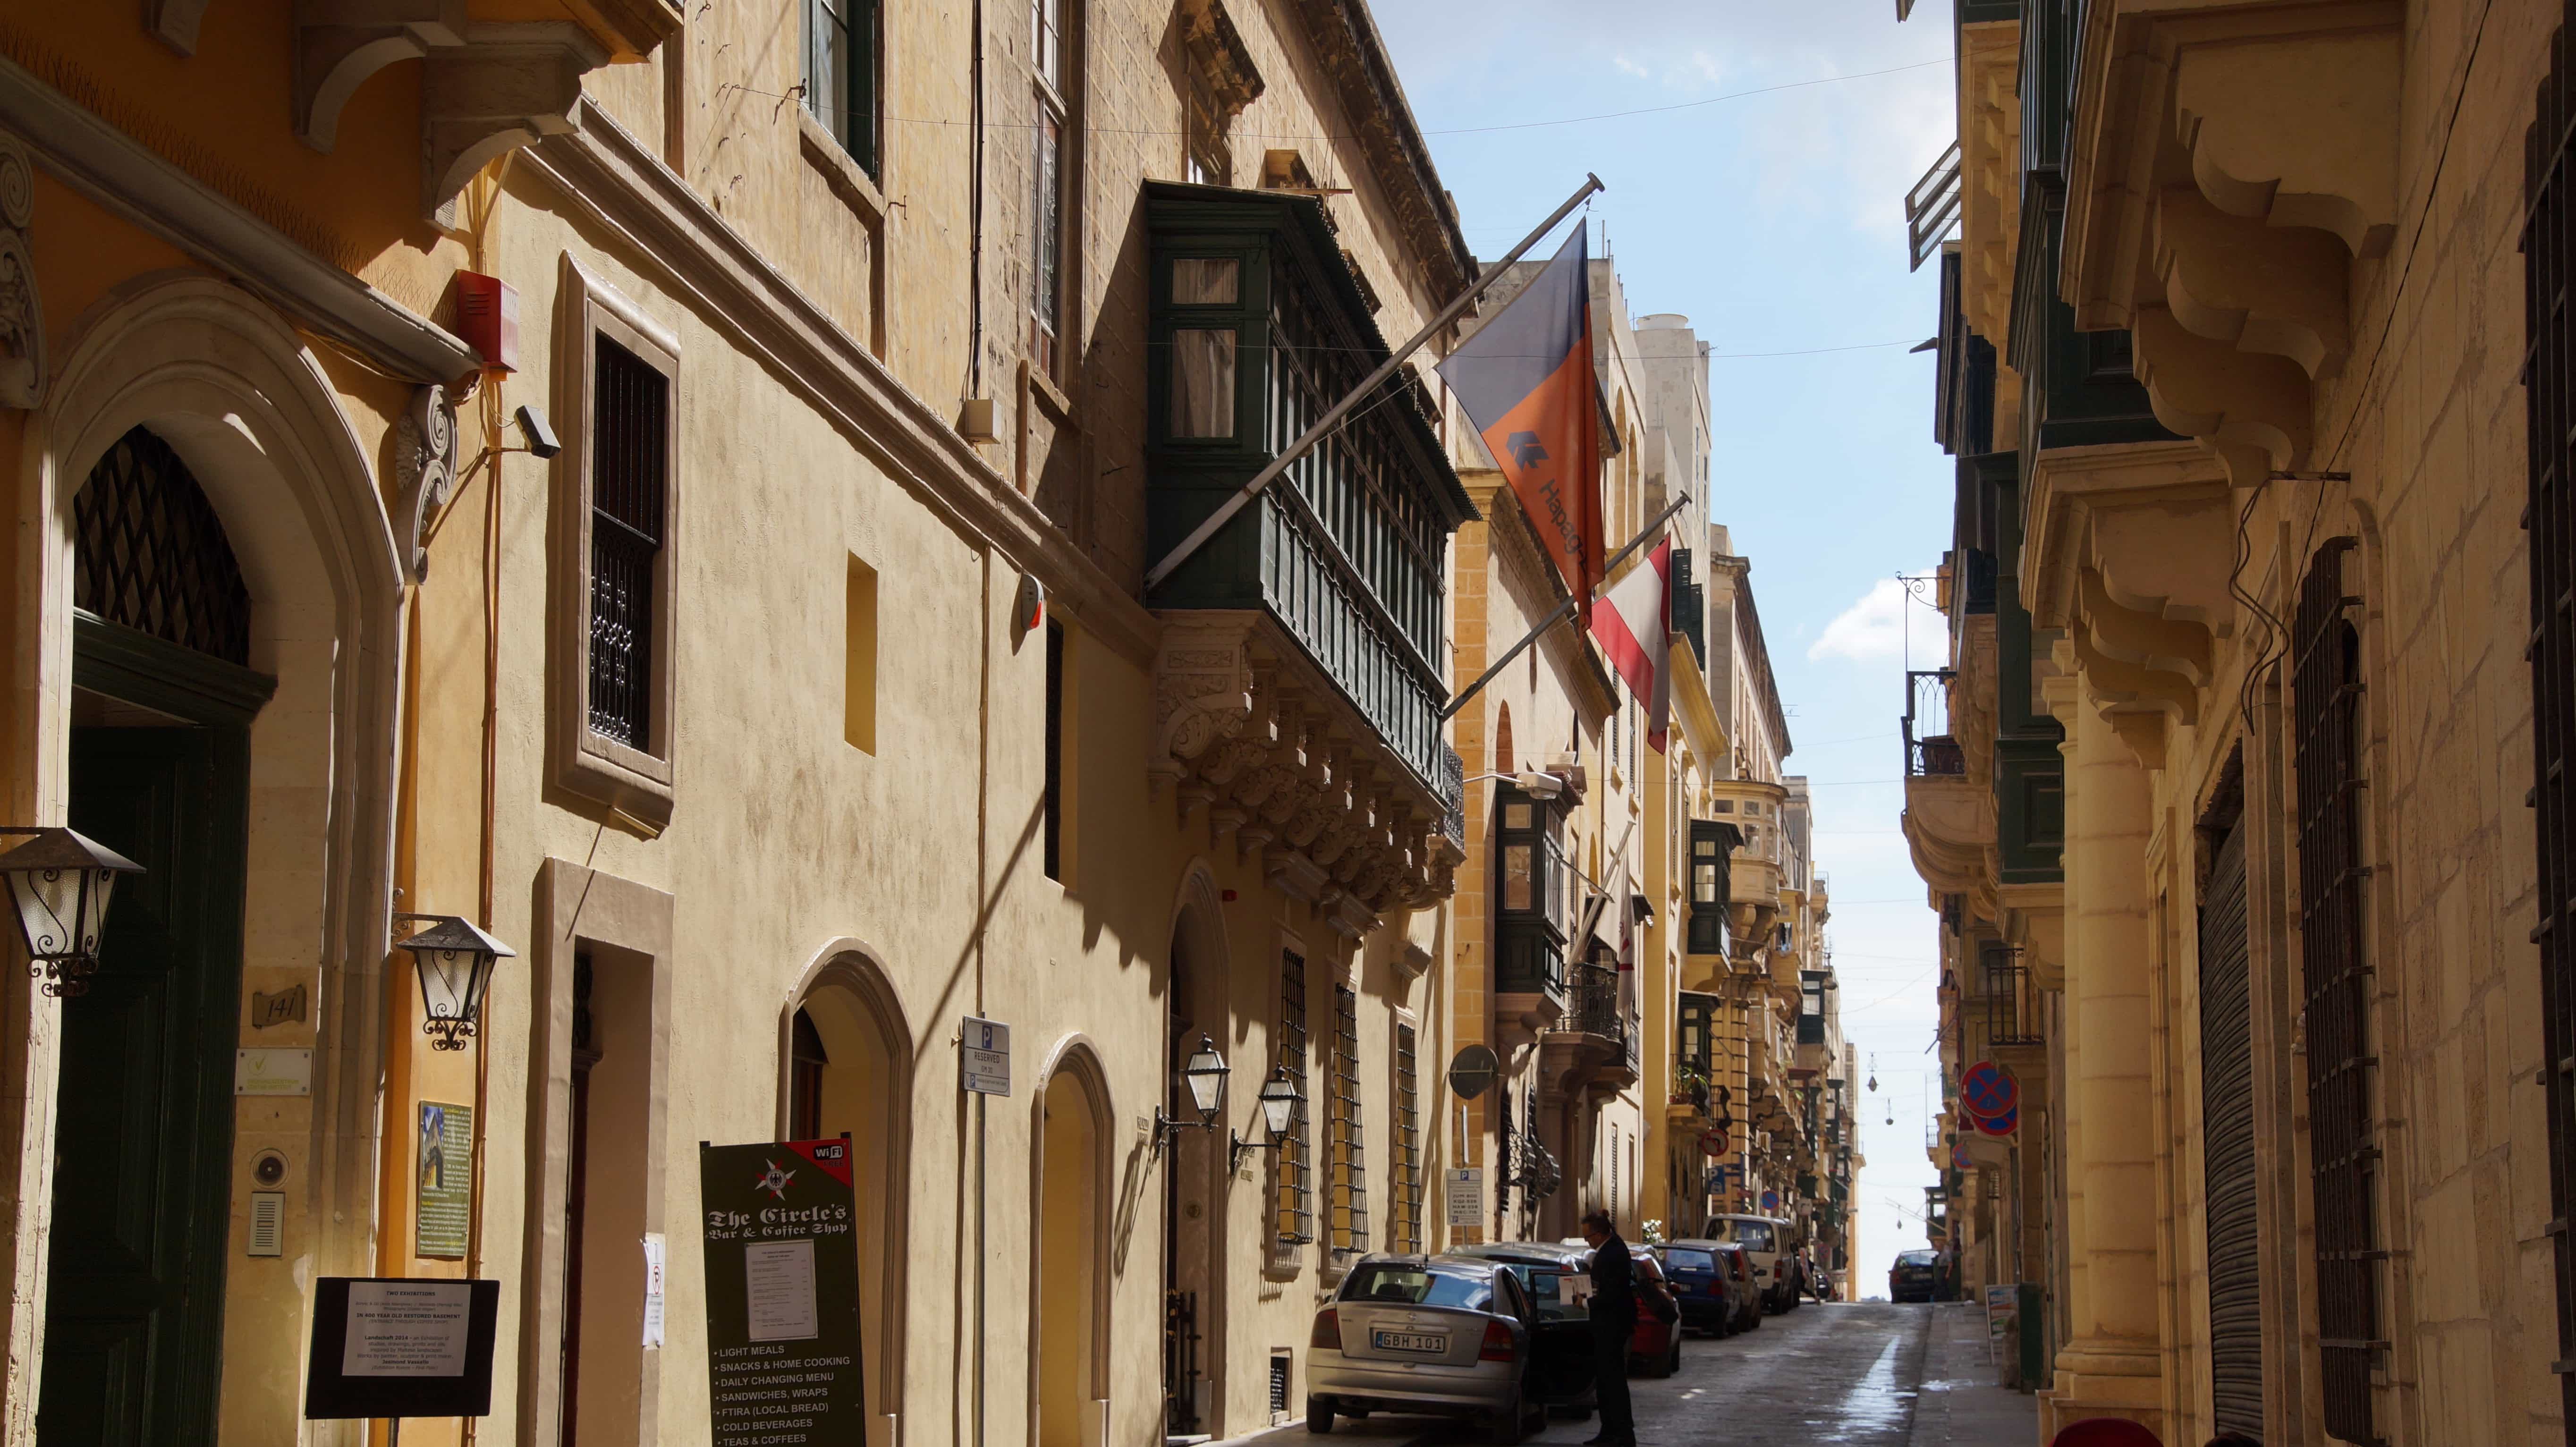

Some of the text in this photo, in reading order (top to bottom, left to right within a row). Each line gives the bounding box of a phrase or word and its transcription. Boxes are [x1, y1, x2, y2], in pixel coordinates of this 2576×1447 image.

[267, 997, 294, 1018] 141
[974, 1051, 1000, 1064] RESERVED
[816, 1146, 842, 1158] WiFi
[1462, 1172, 1467, 1180] P
[709, 1203, 847, 1230] The Circle's
[709, 1223, 847, 1239] Bar & Coffee Shop
[1384, 1334, 1441, 1350] GBH 101
[720, 1345, 785, 1357] LIGHT MEALS
[720, 1356, 850, 1371] SNACKS & HOME COOKING
[721, 1372, 834, 1387] DAILY CHANGING MENU
[721, 1388, 828, 1402] SANDWICHES, WRAPS
[722, 1403, 829, 1416] FTIRA (LOCAL BREAD)
[723, 1419, 813, 1432] COLD BEVERAGES
[723, 1434, 807, 1447] TEAS & COFFEES
